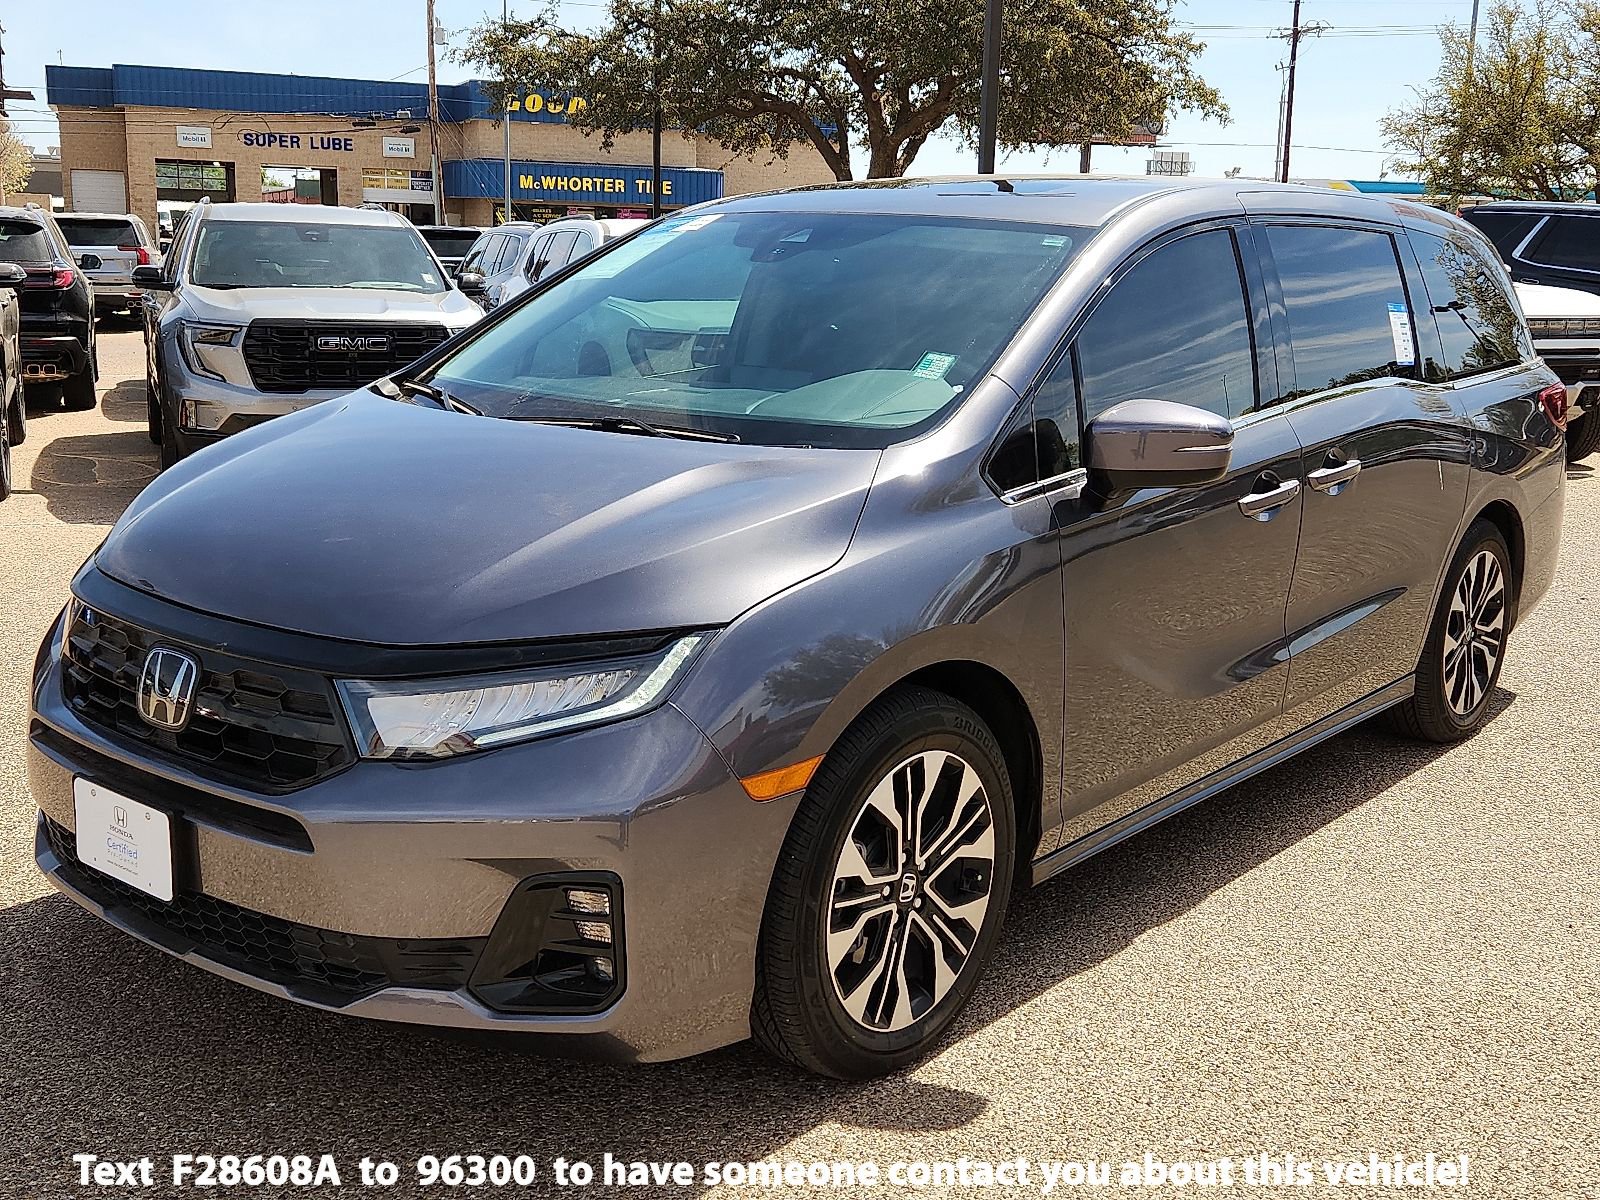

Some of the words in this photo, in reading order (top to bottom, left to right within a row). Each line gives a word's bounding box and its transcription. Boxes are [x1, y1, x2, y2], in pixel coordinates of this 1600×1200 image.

[182, 135, 200, 143] Mobil
[243, 132, 301, 149] SUPER
[310, 136, 354, 152] LUBE
[519, 174, 625, 193] McWHORTER
[635, 179, 672, 195] TIE
[317, 336, 389, 351] GMC
[109, 824, 134, 840] HONDA
[106, 837, 138, 859] Certified
